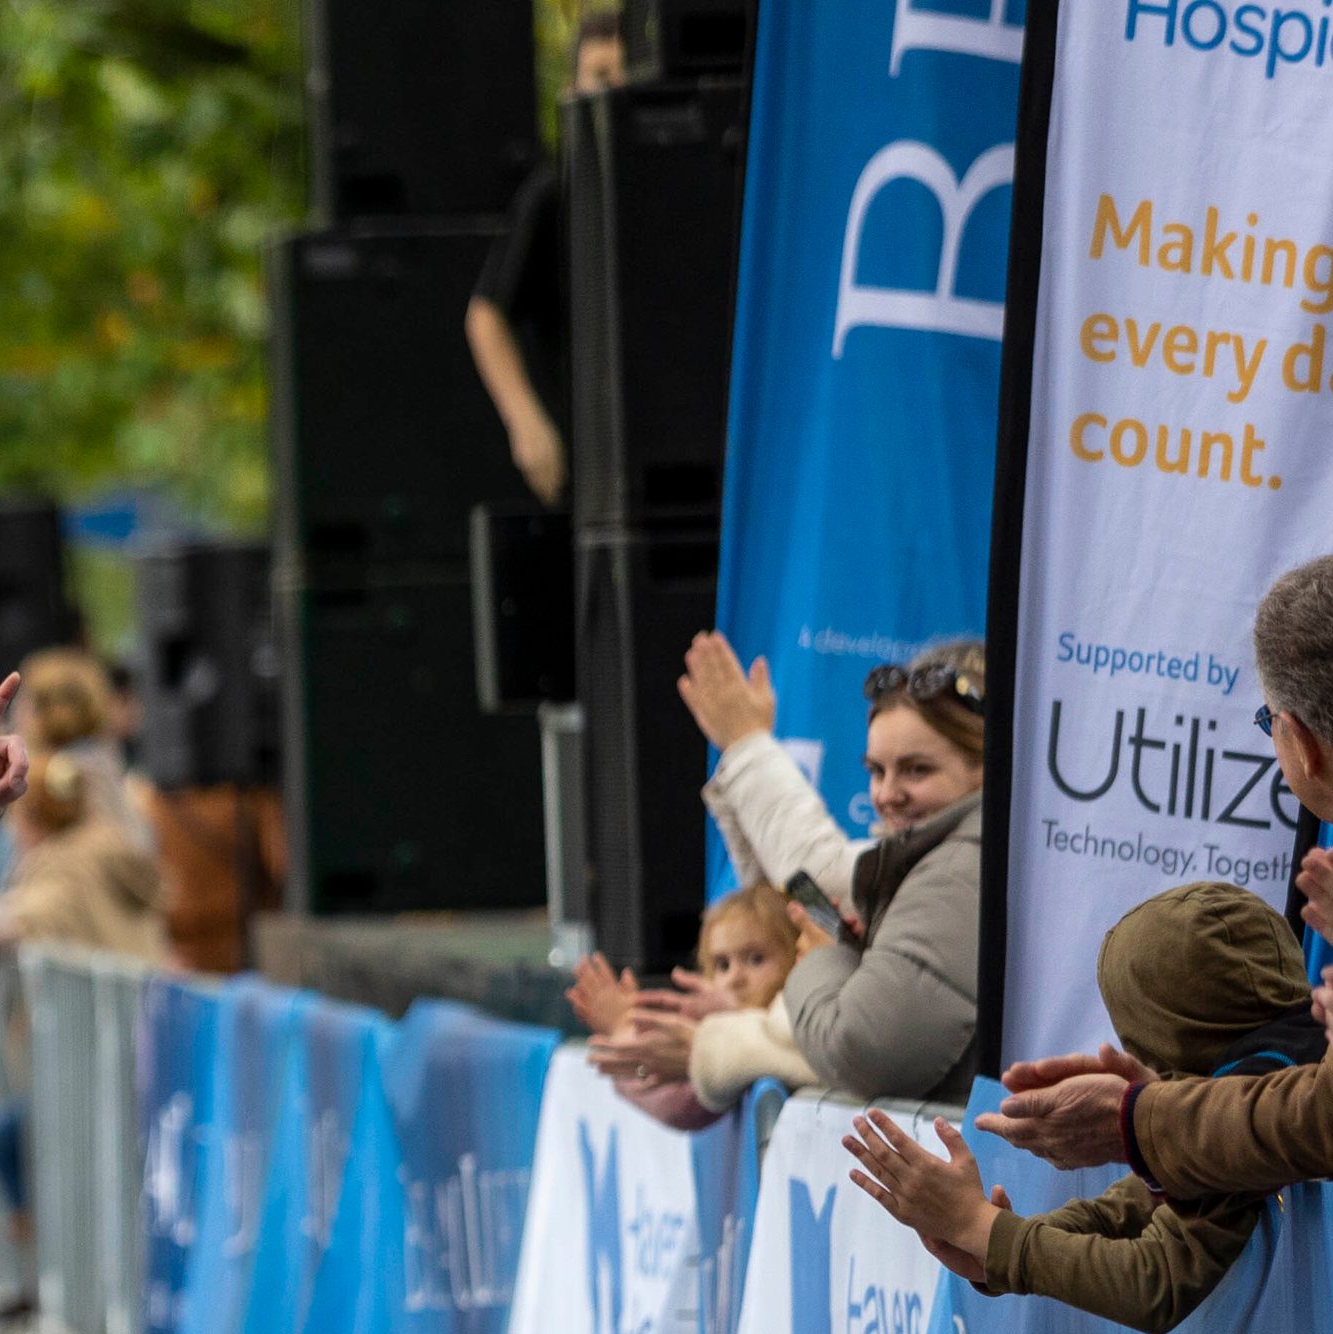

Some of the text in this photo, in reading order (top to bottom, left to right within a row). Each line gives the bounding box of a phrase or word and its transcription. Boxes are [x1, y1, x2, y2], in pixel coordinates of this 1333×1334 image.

[1125, 0, 1333, 79] Hospi
[1089, 193, 1333, 315] Making
[1079, 312, 1333, 403] every d
[1069, 411, 1282, 490] count.
[1057, 632, 1239, 696] Supported by
[1041, 817, 1199, 878] Technology.
